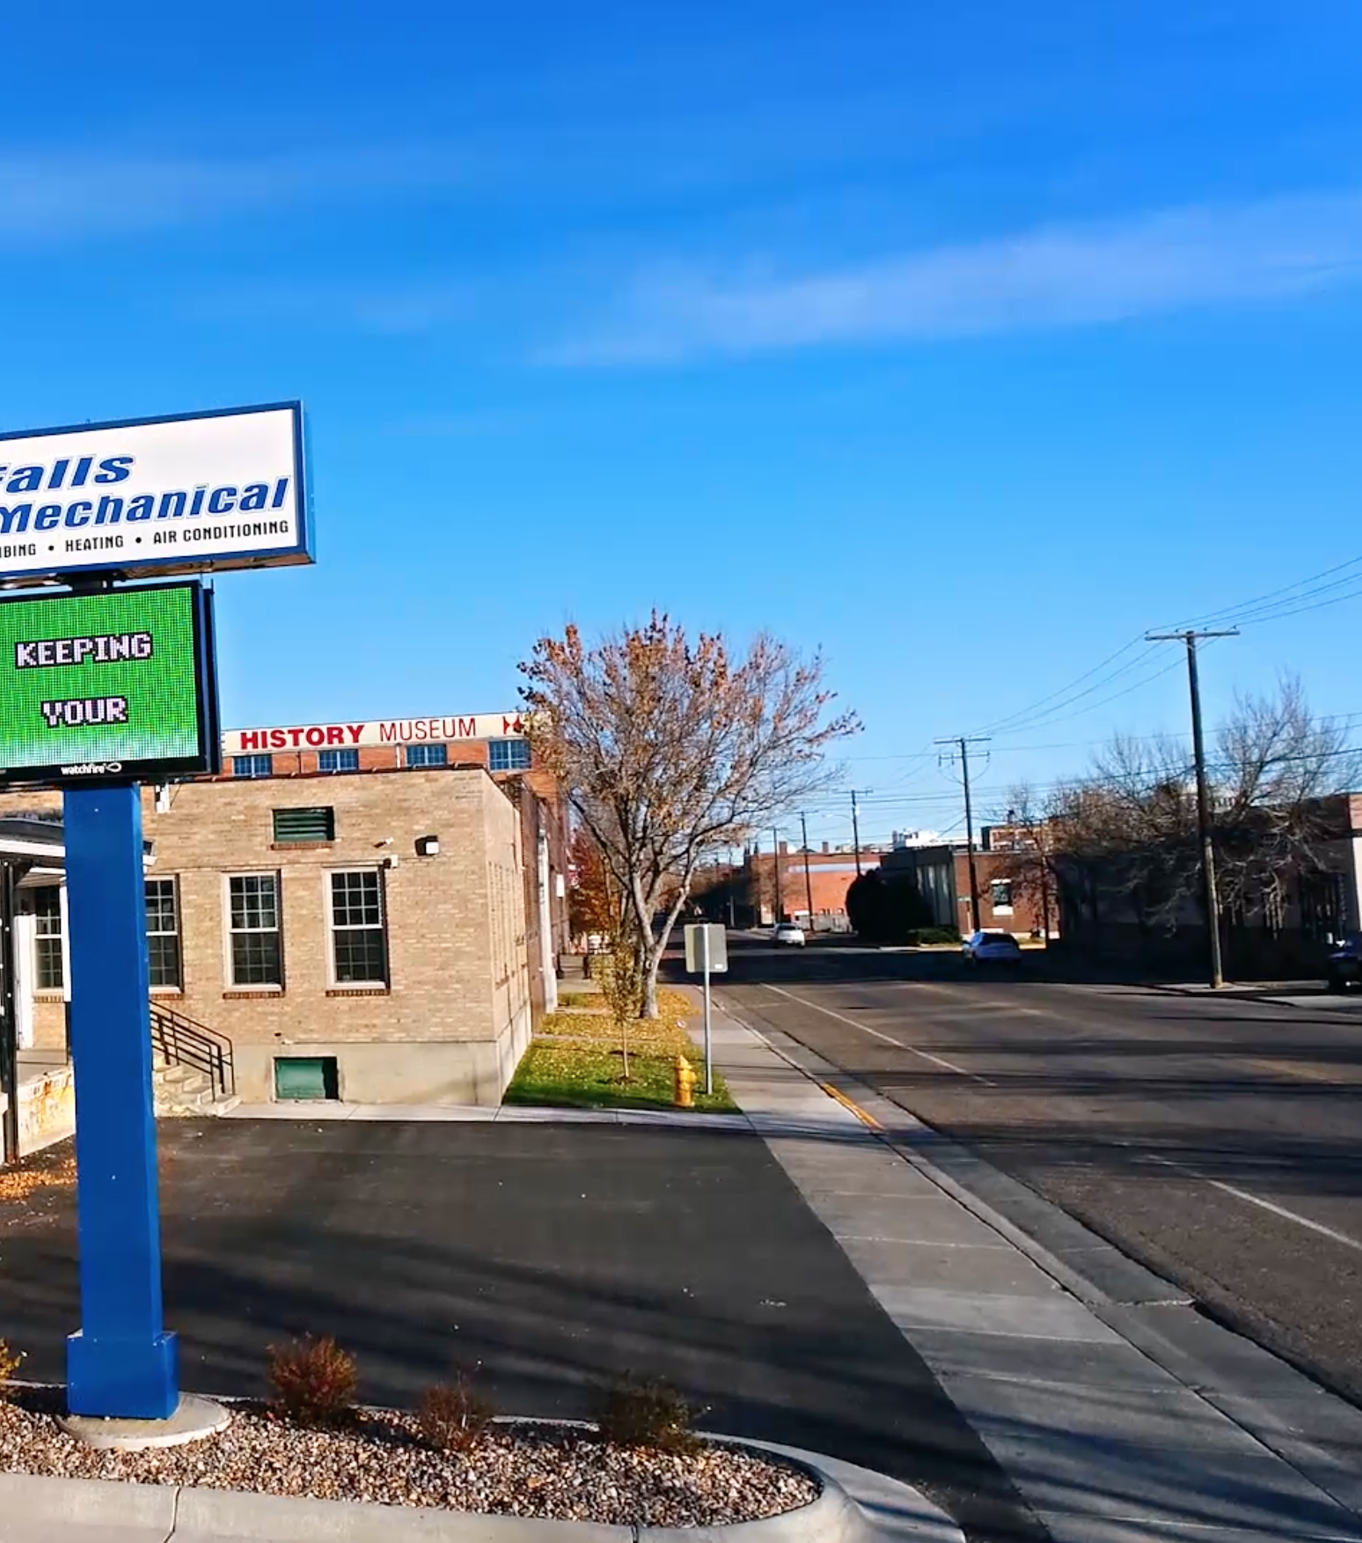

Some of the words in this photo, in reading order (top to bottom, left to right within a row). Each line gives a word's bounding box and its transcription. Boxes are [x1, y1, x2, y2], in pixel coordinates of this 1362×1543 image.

[65, 535, 124, 552] HEATING
[153, 530, 177, 545] AIR
[183, 520, 289, 542] CONDITIONING
[16, 634, 153, 668] KEEPING
[42, 697, 128, 727] YOUR
[240, 724, 365, 750] HISTORY
[379, 718, 477, 742] MUSEUM
[61, 764, 104, 775] watchfire
